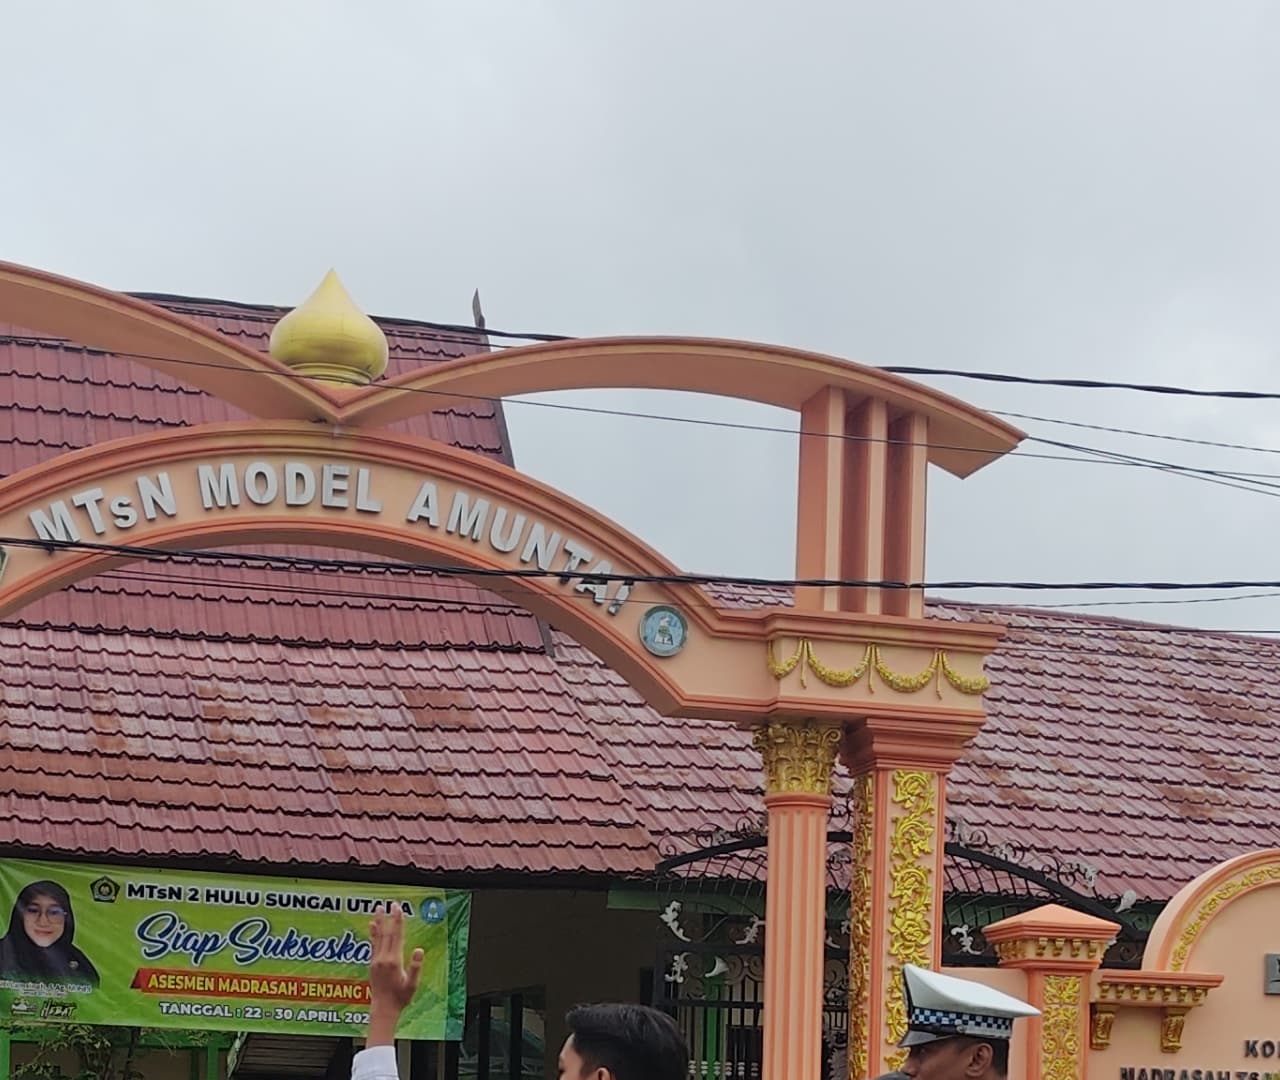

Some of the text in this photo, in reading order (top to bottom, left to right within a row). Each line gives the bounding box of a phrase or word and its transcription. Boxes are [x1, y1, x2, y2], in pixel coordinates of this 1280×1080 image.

[29, 471, 178, 543] MTsN
[198, 462, 382, 514] MODEL
[127, 882, 183, 901] MTsN
[187, 888, 200, 902] 2
[205, 889, 259, 907] HULU
[265, 893, 341, 912] SUNGAI
[136, 912, 371, 967] Siap Sukseska
[147, 974, 215, 992] ASESMEN
[218, 977, 298, 996] MADRASAH
[300, 980, 362, 999] JENJANG
[159, 1002, 233, 1018] TANGGAL
[245, 1007, 262, 1019] 22
[275, 1008, 293, 1021] 30
[296, 1009, 340, 1023] APRIL
[343, 1012, 369, 1025] 202
